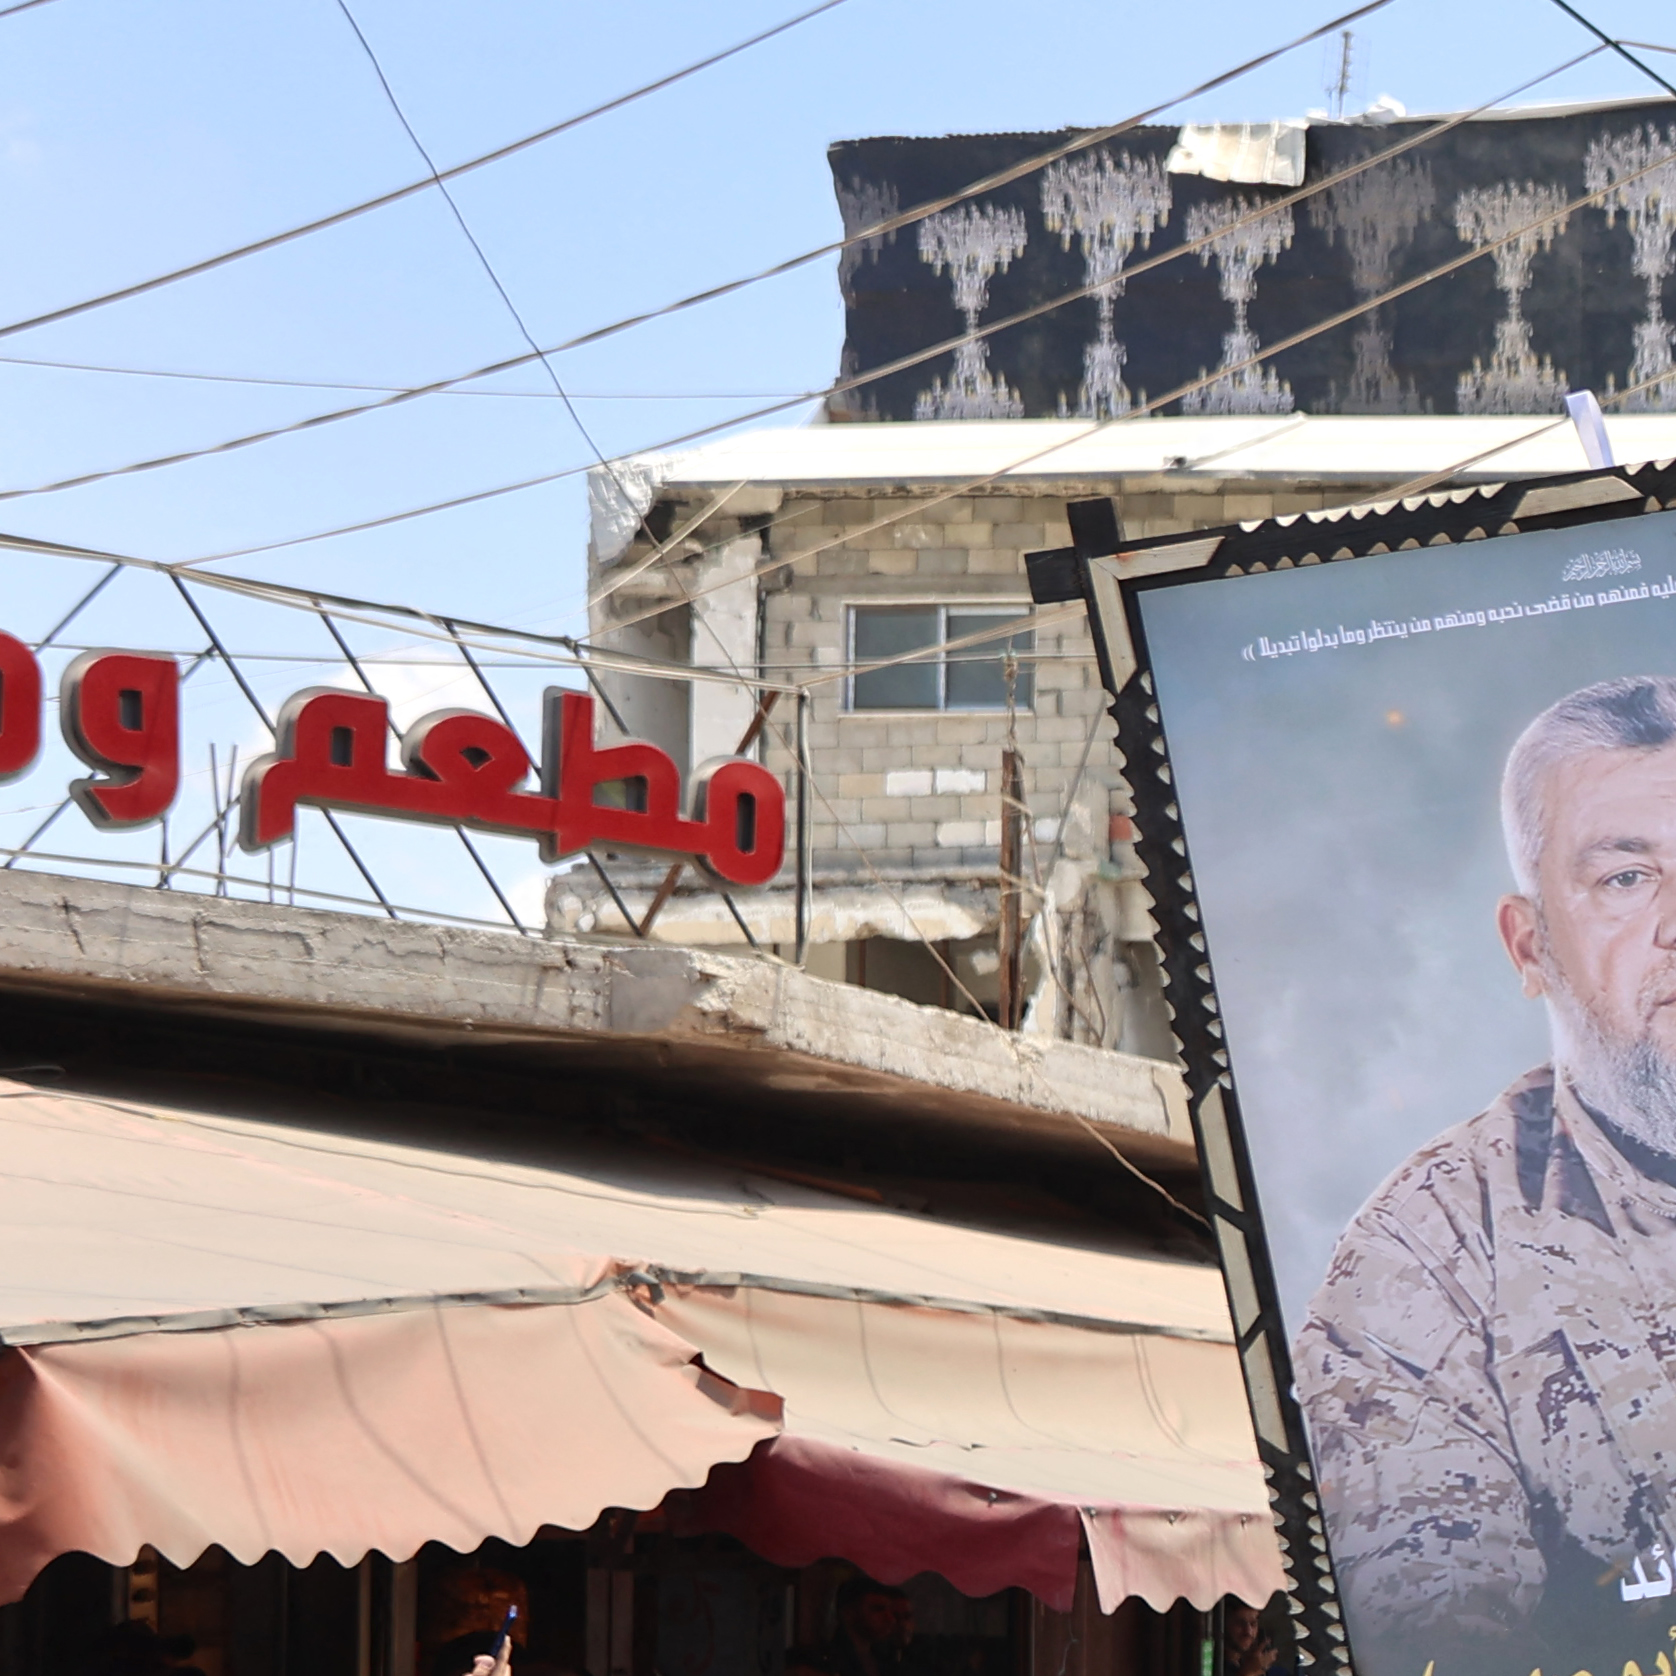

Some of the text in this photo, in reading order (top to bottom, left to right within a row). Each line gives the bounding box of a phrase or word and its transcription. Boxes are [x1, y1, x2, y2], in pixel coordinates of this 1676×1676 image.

[1526, 592, 1571, 617] قضى
[1573, 591, 1596, 608] من
[1598, 582, 1650, 608] فمنهم
[1434, 610, 1487, 633] ومنهم
[1488, 602, 1524, 624] نحبه
[1338, 625, 1366, 646] وما
[1366, 619, 1409, 643] ينتظر
[1410, 619, 1431, 634] من
[1259, 635, 1301, 658] تبديلا
[1301, 631, 1338, 653] بدلوا
[240, 686, 785, 890] مطعم
